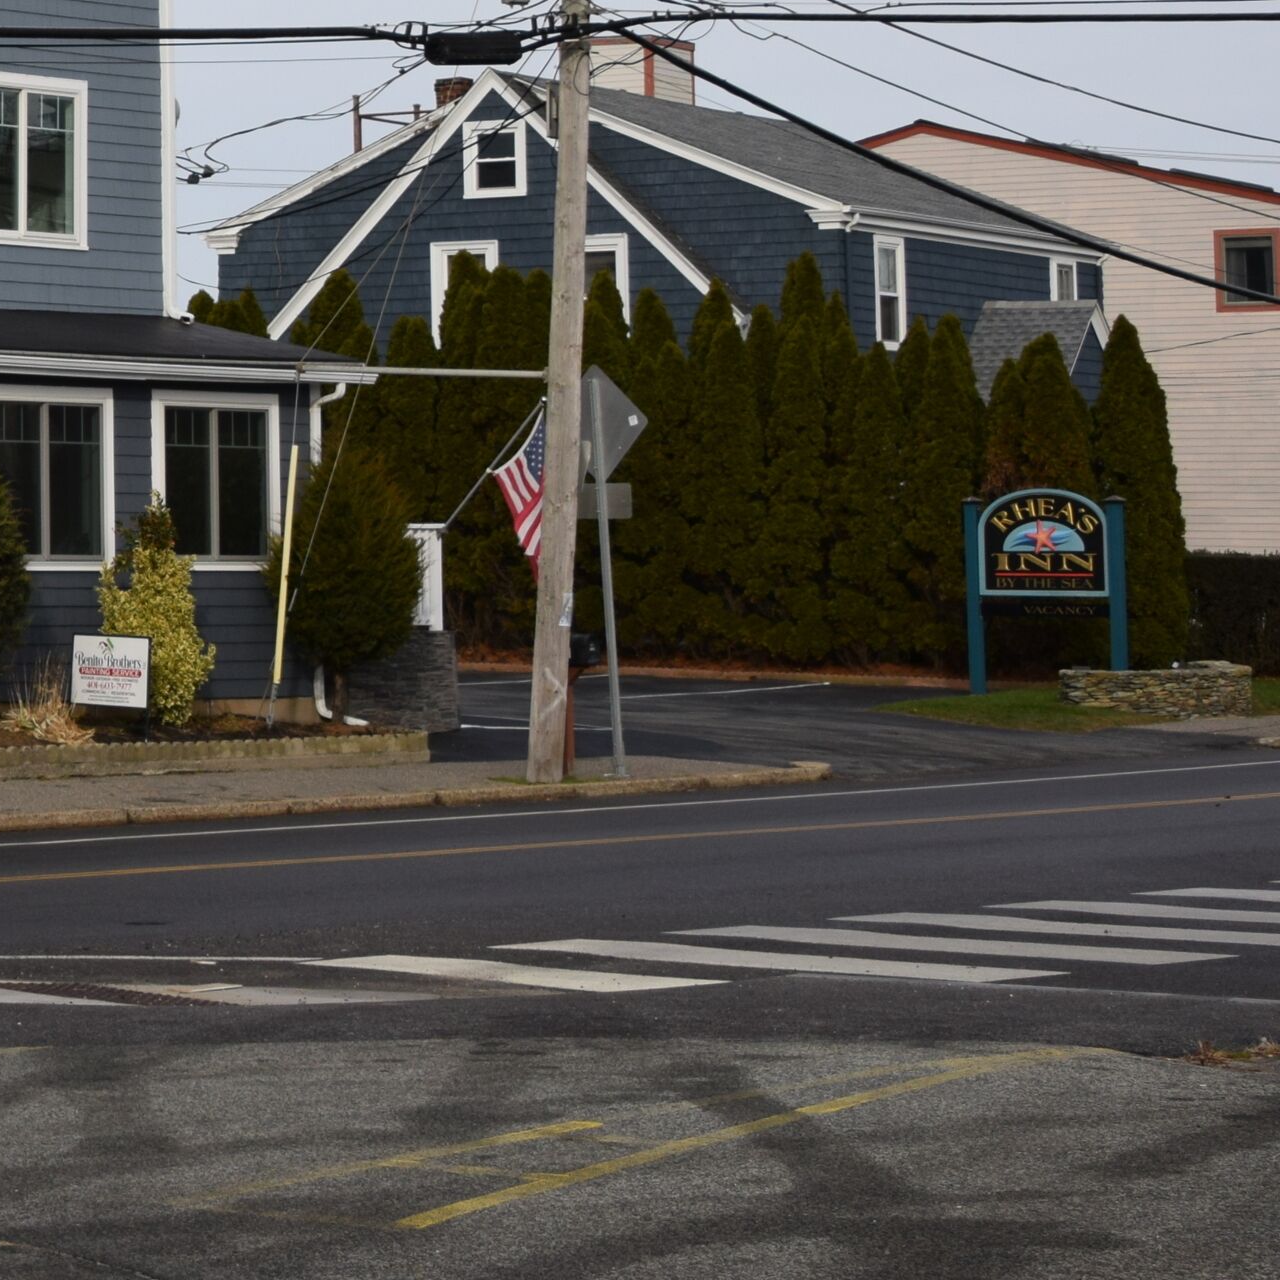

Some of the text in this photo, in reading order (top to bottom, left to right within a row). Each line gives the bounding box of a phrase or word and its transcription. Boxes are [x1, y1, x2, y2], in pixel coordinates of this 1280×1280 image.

[991, 498, 1100, 534] RHEA'S
[991, 552, 1097, 572] INN
[996, 577, 1094, 589] BY THE SEA
[1023, 605, 1097, 616] VACANCY
[75, 651, 104, 666] Benito
[104, 652, 142, 668] Brothers
[81, 667, 140, 677] PAINTING SERVICE
